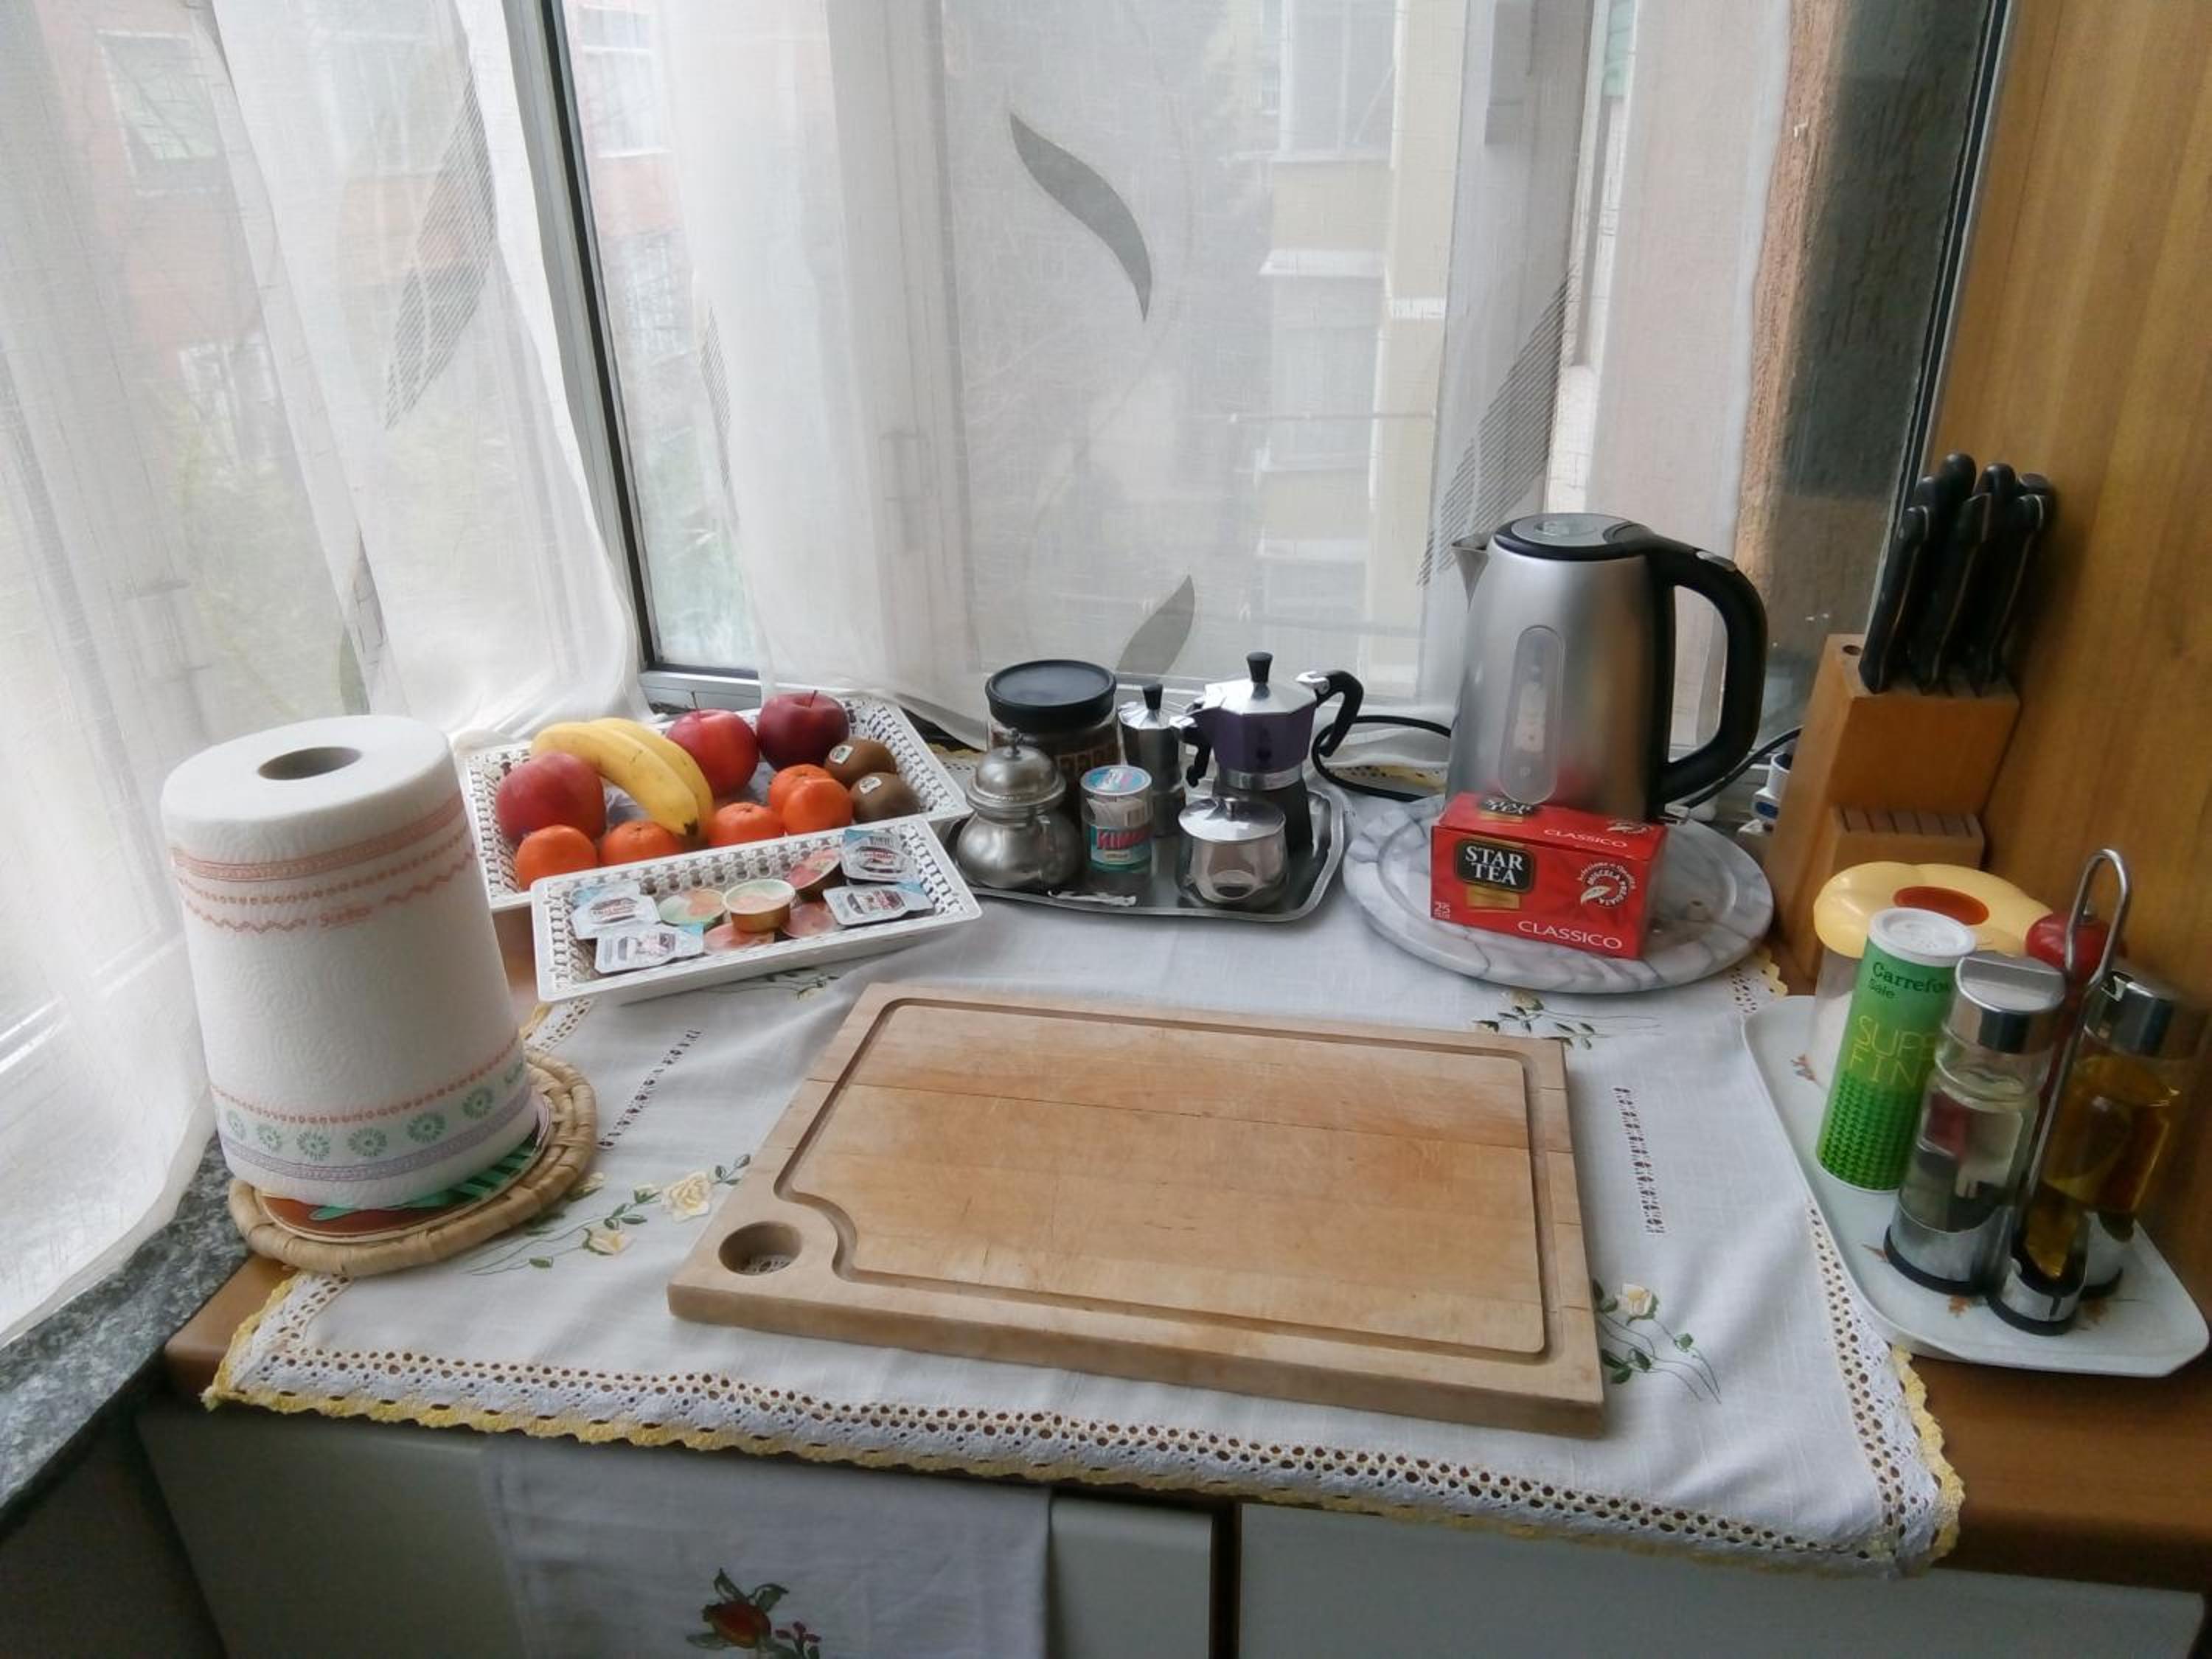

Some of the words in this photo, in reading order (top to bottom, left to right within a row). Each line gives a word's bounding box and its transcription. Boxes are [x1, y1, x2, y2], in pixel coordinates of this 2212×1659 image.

[1544, 829, 1628, 848] CLASSICO
[1464, 845, 1523, 871] STAR
[1471, 862, 1517, 886] TEA
[1517, 920, 1623, 949] CLASSICO
[1868, 978, 1895, 999] Sale
[1856, 1015, 1937, 1062] SUPE
[1850, 1043, 1921, 1087] FIN
